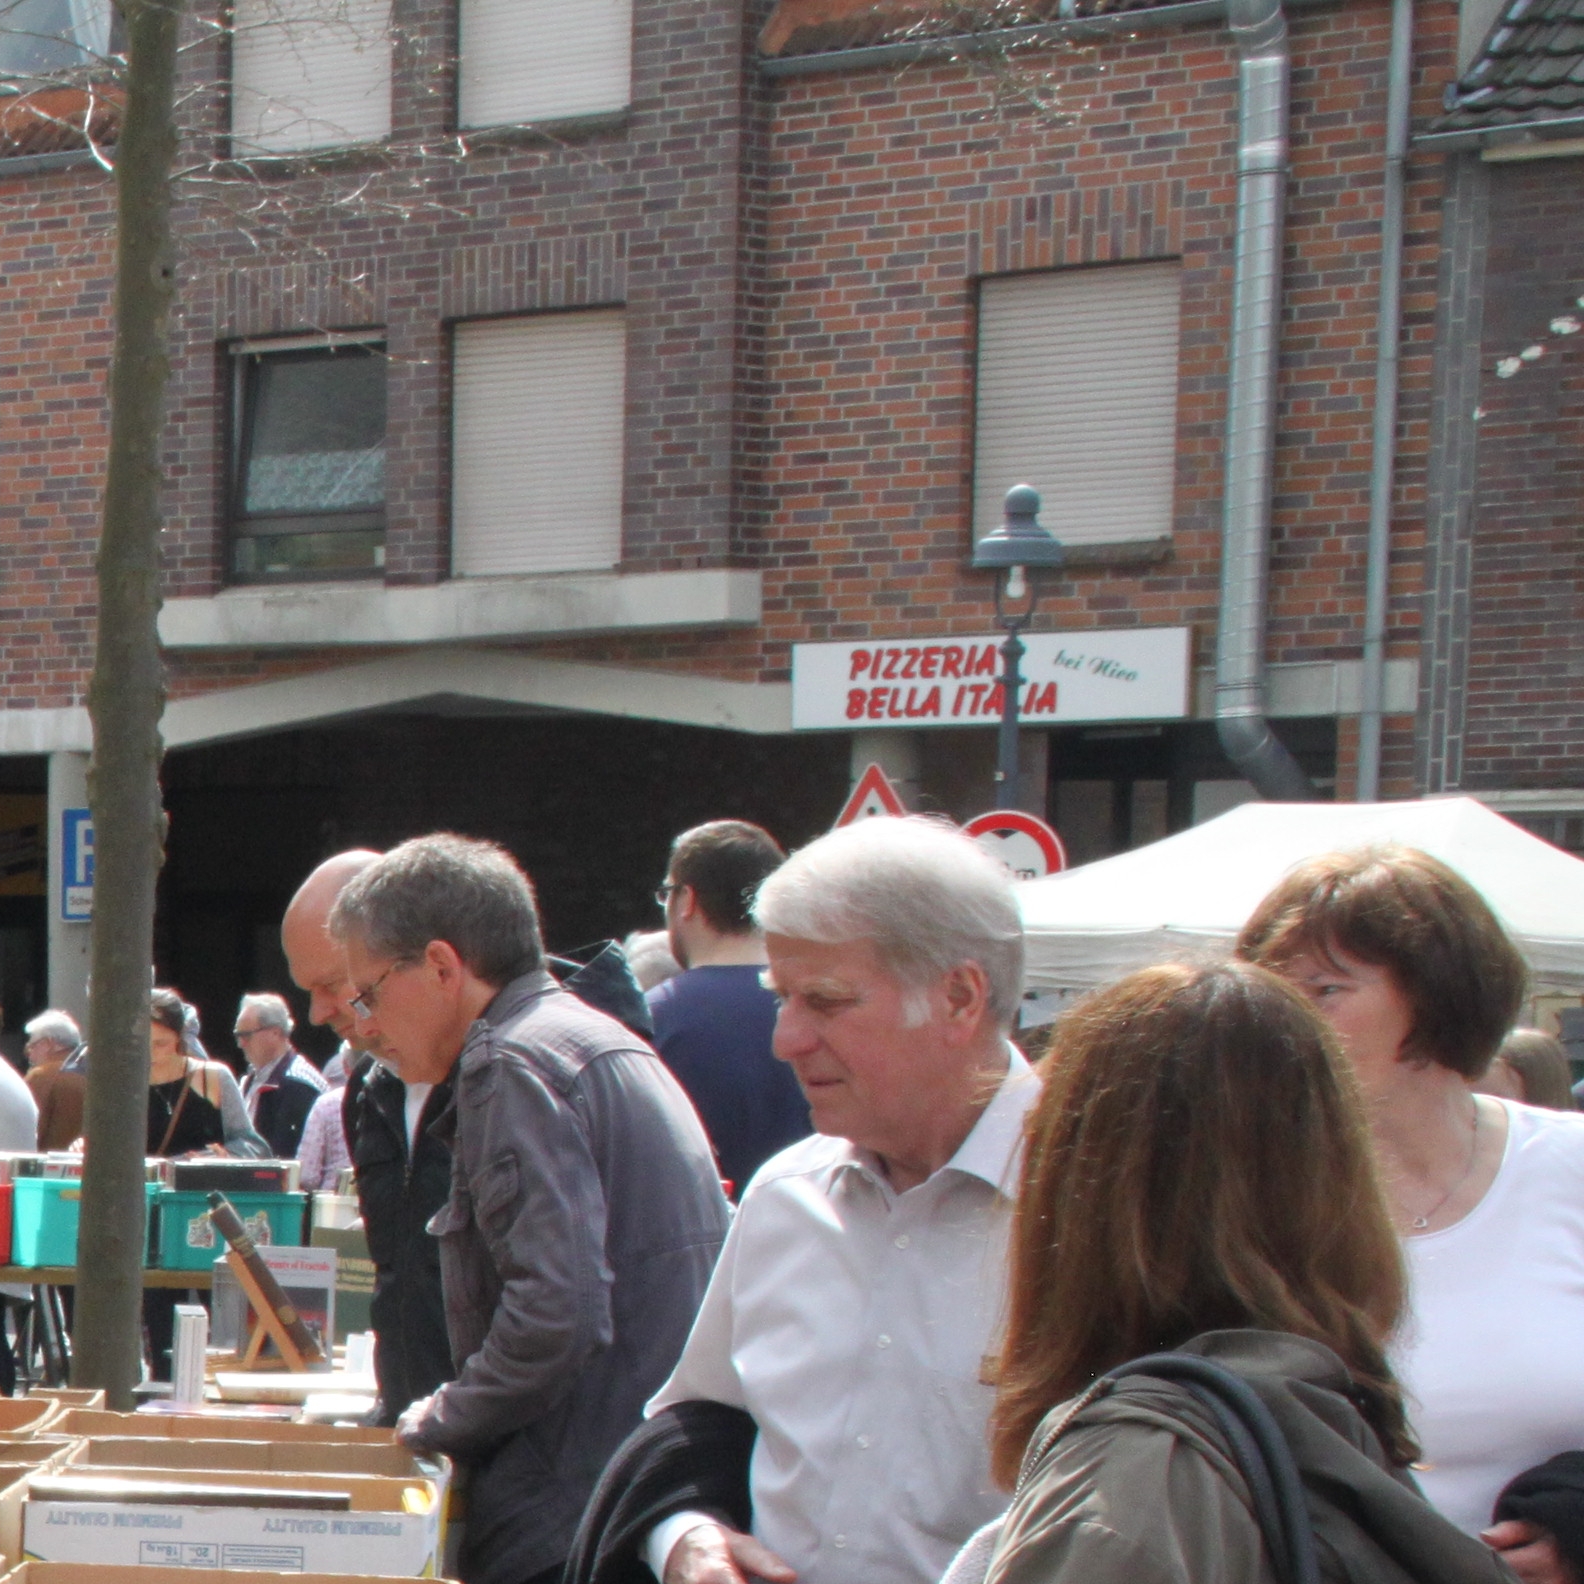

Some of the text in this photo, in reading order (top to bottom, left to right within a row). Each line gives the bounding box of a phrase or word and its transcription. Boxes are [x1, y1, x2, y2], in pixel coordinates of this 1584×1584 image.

[848, 644, 997, 681] PIZZERIA
[1053, 649, 1083, 671] bei
[845, 681, 1058, 720] BELLA ITAIA
[46, 1510, 183, 1529] PREMIUM QUALITY
[262, 1518, 403, 1536] PREMIUM QUALITY
